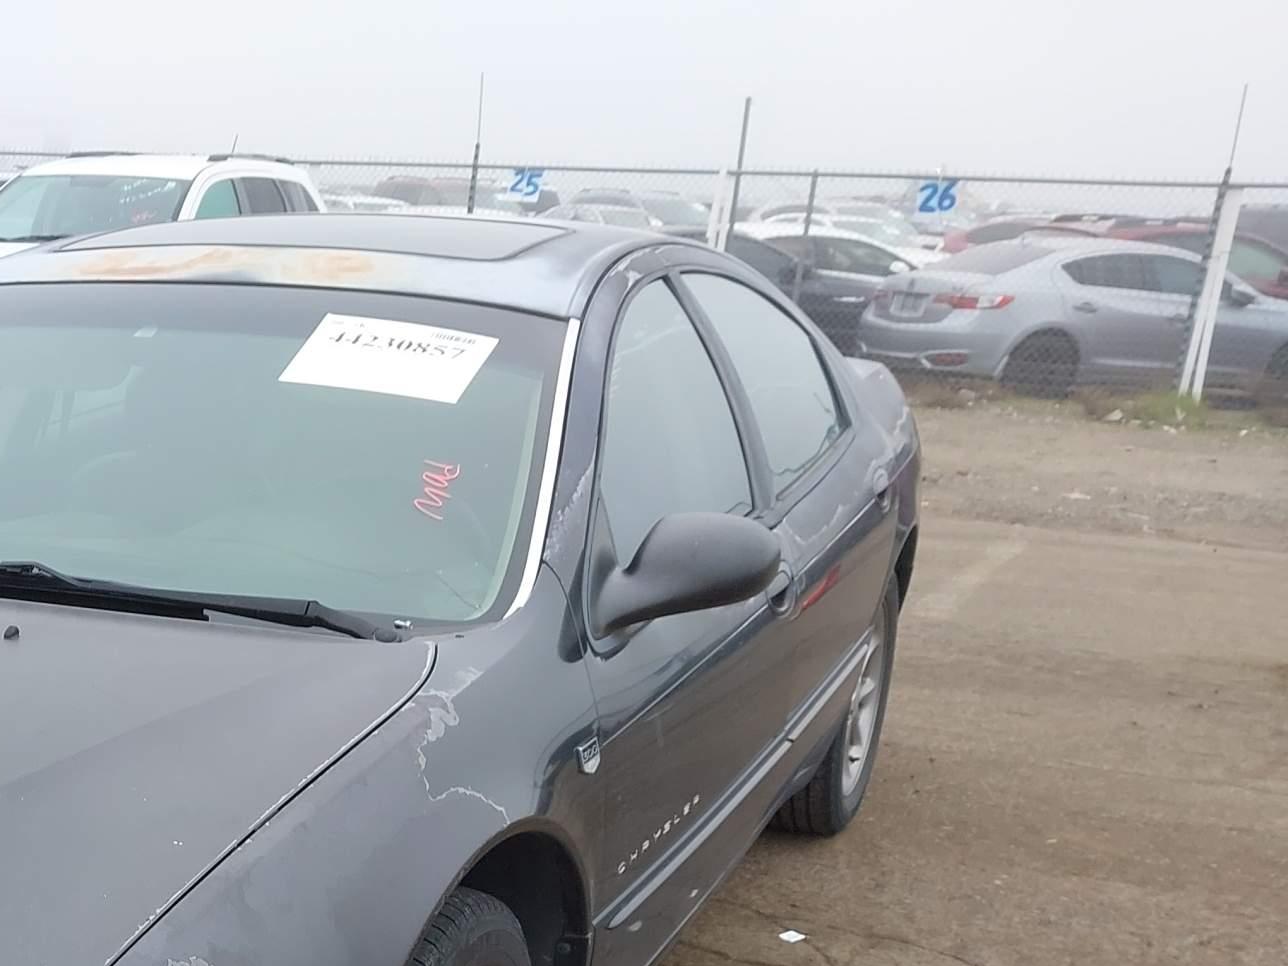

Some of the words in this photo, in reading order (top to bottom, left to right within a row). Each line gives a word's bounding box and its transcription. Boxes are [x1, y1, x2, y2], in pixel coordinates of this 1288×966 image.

[510, 169, 543, 196] 25
[919, 179, 959, 212] 26
[328, 331, 466, 360] 44230857
[617, 794, 700, 875] CHRYSLER
